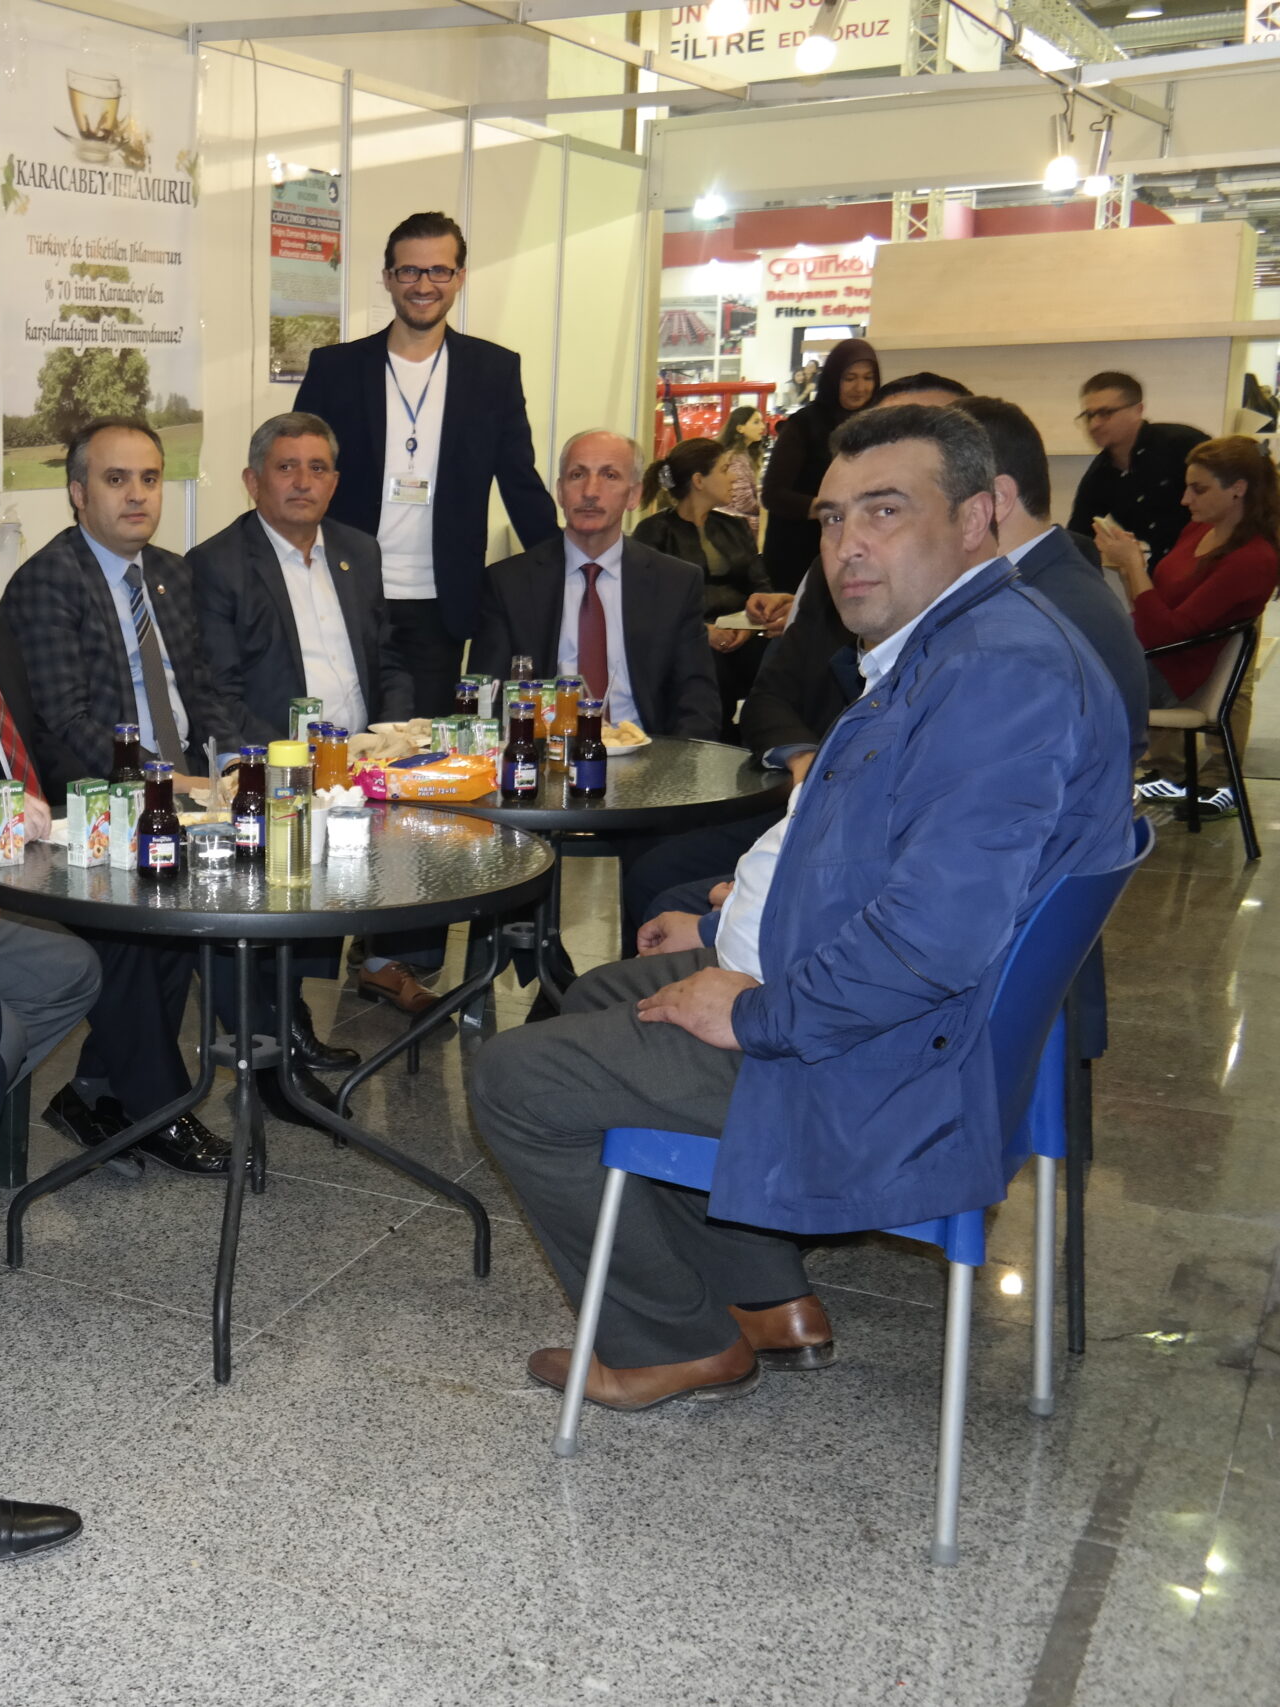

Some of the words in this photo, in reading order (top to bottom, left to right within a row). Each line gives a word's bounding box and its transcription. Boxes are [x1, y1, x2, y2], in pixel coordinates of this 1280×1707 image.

[778, 19, 889, 48] EDORUZ
[15, 159, 109, 196] KARACABEY
[775, 306, 816, 318] Filtre
